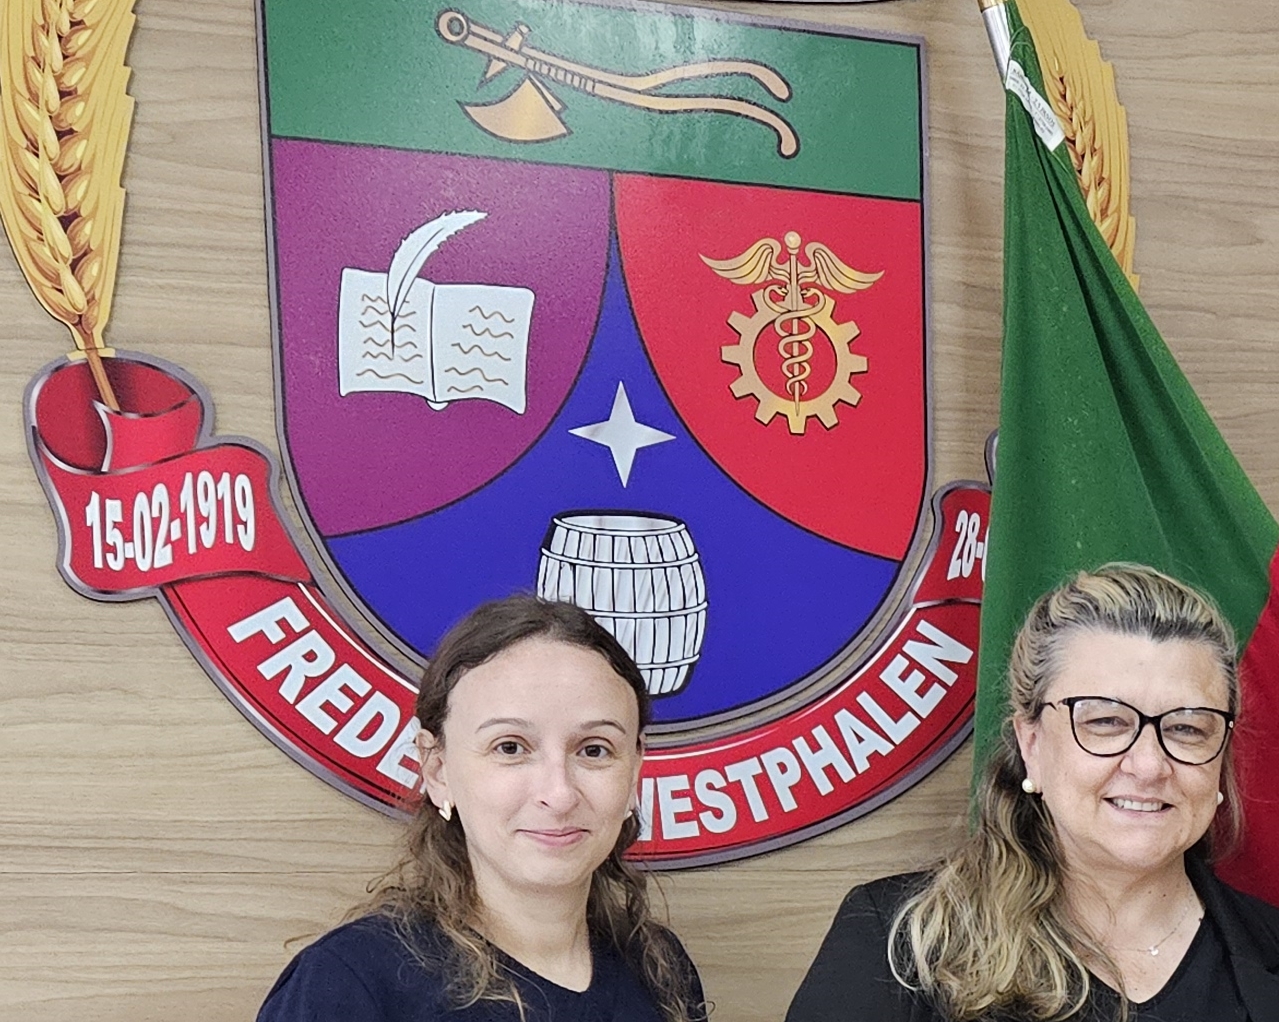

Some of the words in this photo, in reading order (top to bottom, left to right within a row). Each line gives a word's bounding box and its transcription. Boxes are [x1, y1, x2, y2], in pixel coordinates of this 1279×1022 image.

[86, 471, 256, 570] 15-02-1919
[947, 509, 989, 581] 28-
[227, 596, 426, 794] FREDE
